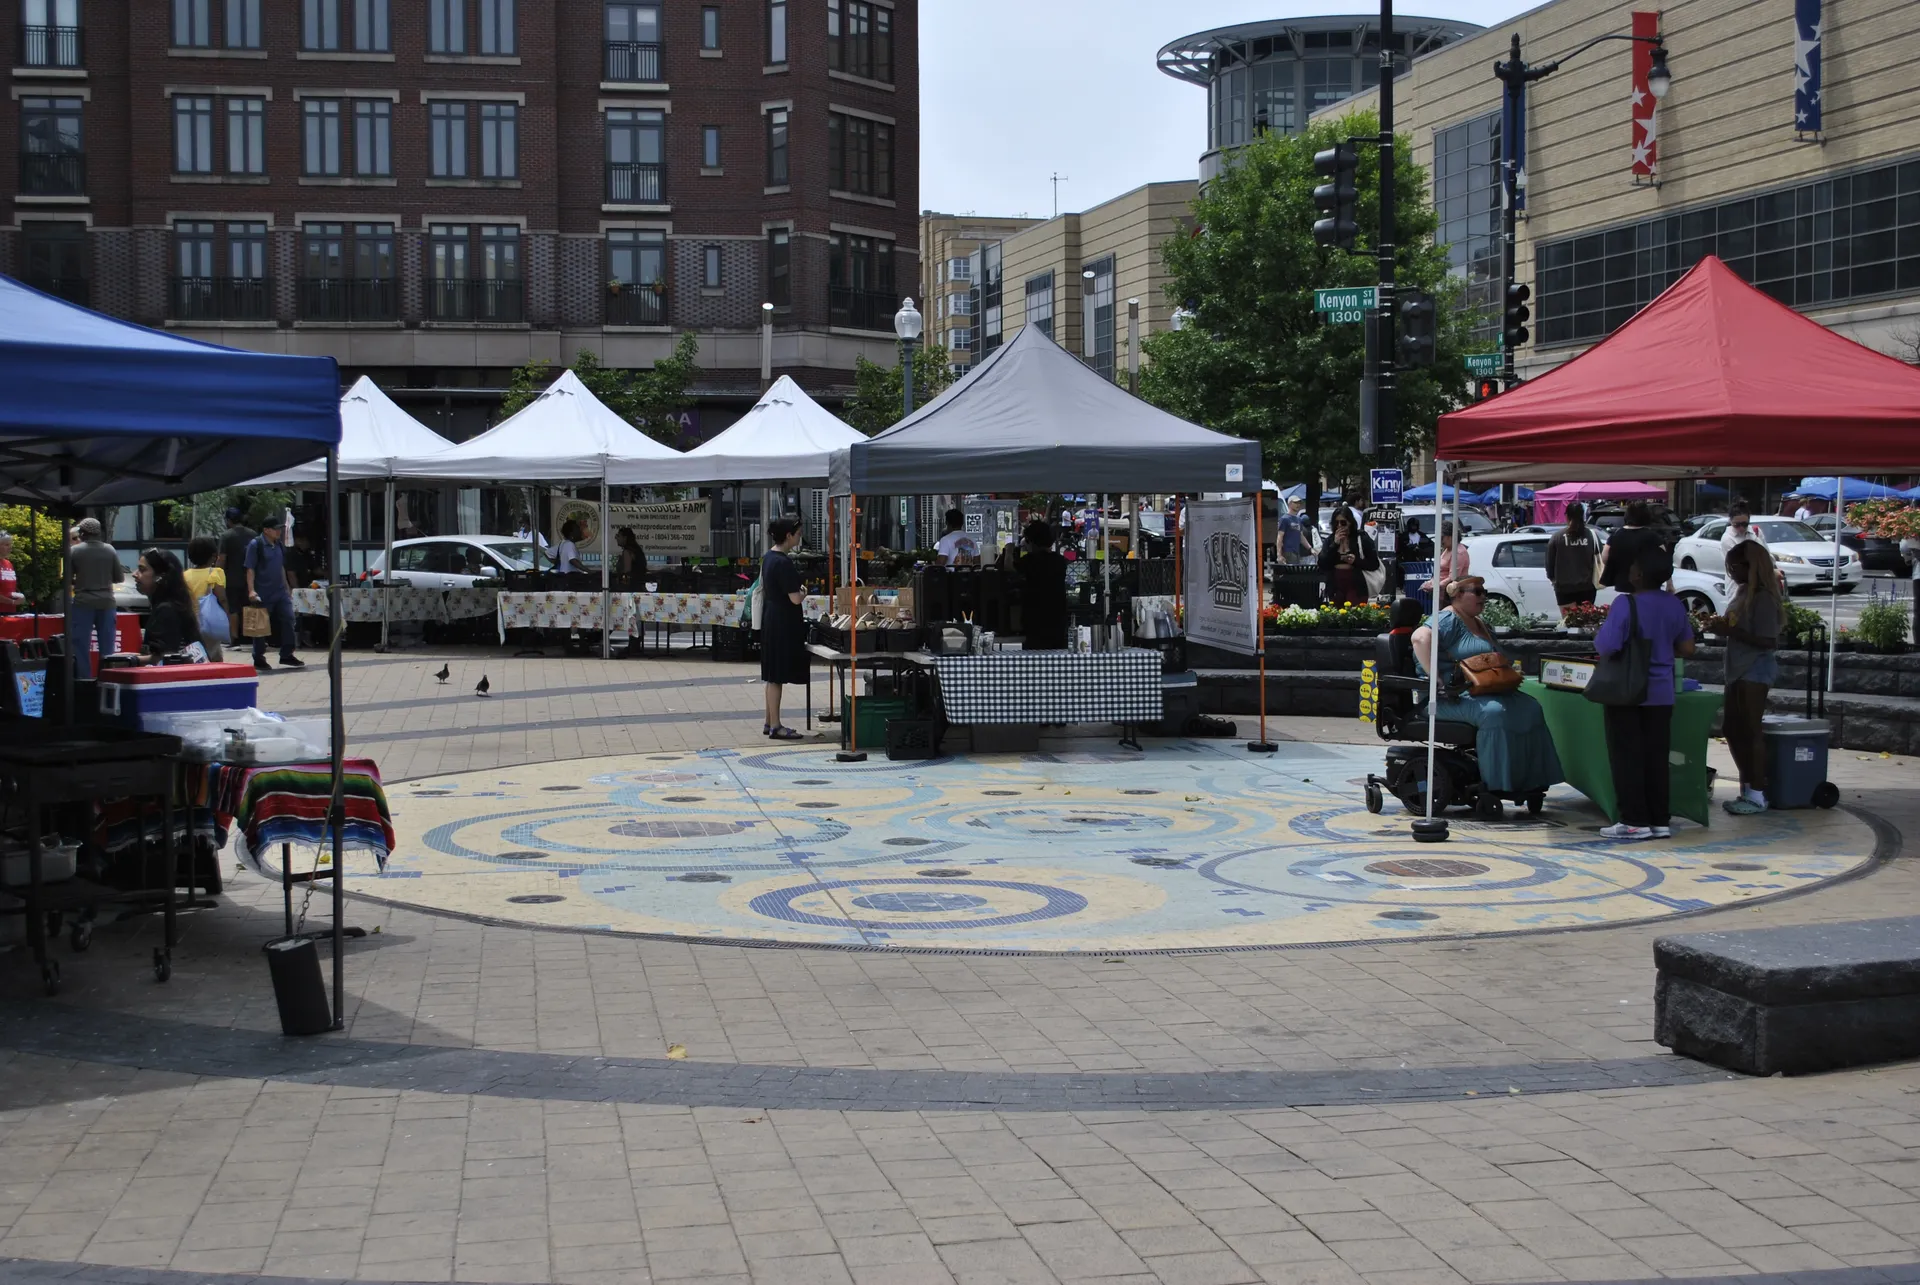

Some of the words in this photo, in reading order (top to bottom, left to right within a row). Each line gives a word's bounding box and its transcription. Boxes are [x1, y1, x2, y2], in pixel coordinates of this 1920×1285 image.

[1363, 290, 1372, 298] ST
[1320, 293, 1357, 310] Kenyon
[1331, 311, 1361, 322] 1300
[1467, 356, 1492, 368] Kenyon
[1475, 368, 1493, 376] 1300
[637, 503, 681, 513] PRODUCE
[682, 502, 707, 513] FARM
[1369, 511, 1386, 520] FREE
[634, 533, 649, 541] strid
[1216, 591, 1240, 604] COFFEE
